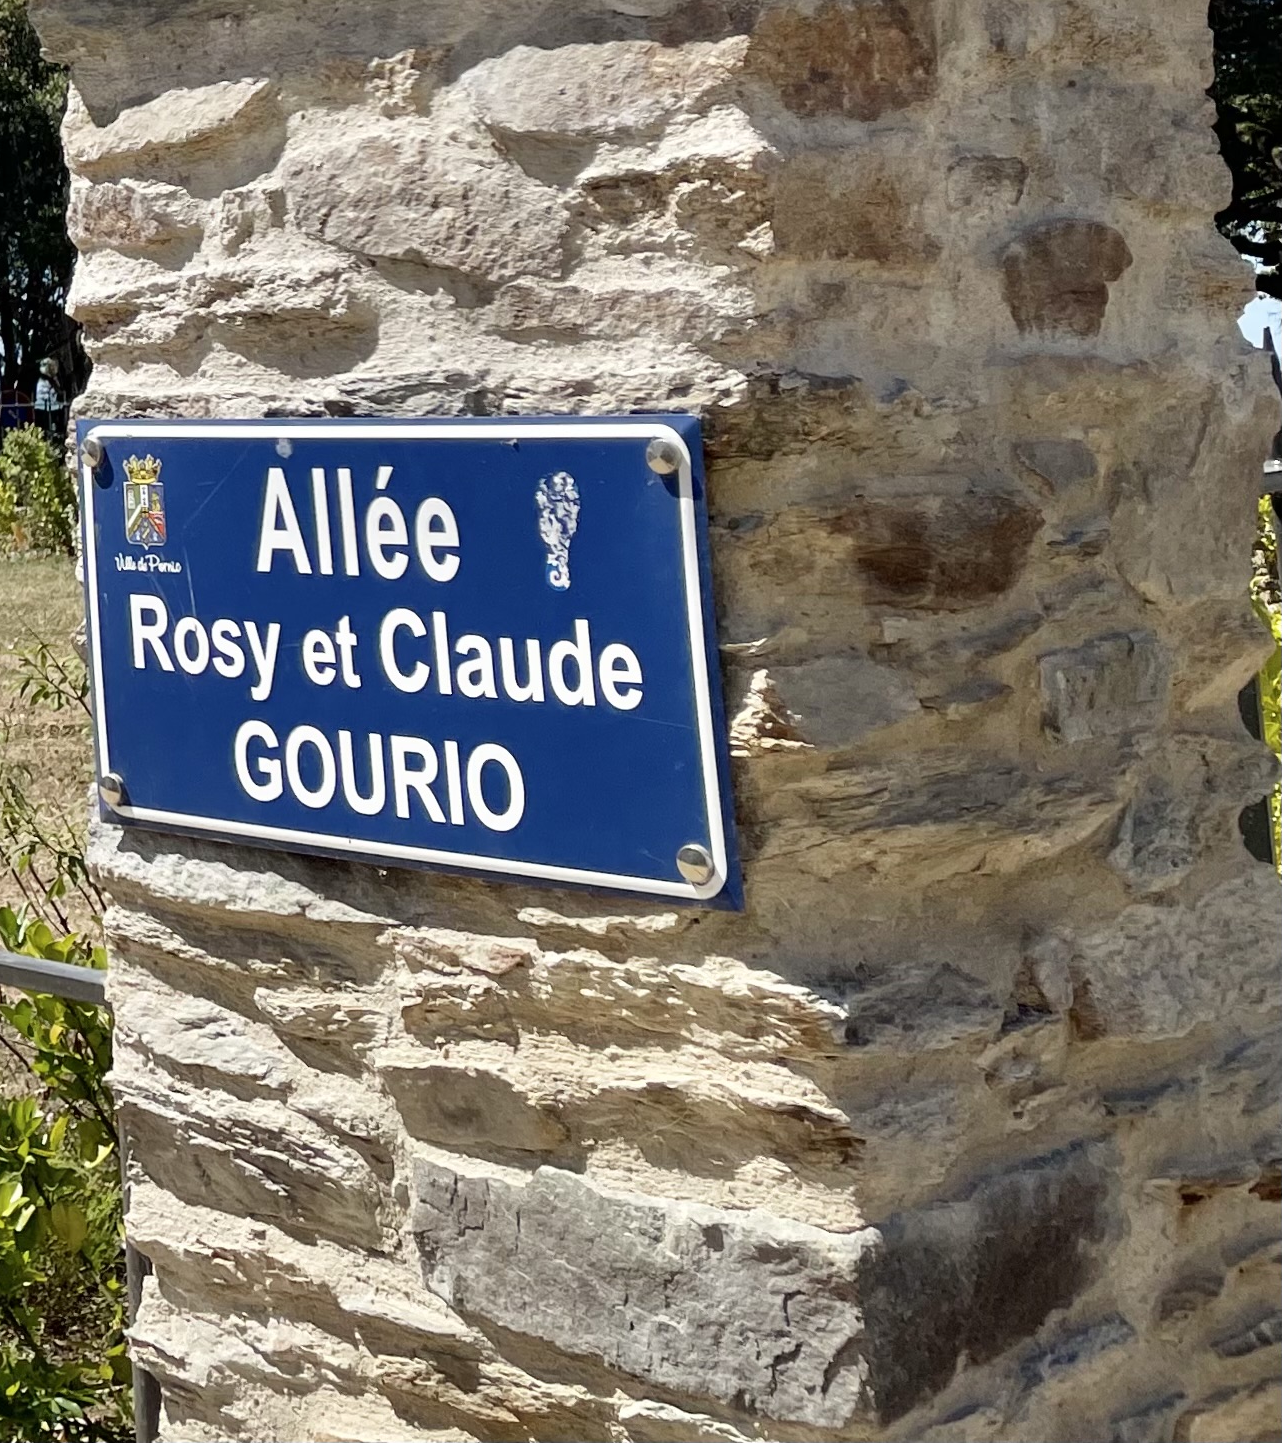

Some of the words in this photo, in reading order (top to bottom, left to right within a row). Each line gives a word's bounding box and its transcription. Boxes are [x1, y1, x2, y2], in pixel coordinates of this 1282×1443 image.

[114, 552, 137, 572] Ville
[256, 465, 461, 583] Allée
[129, 593, 281, 701] Rosy
[302, 615, 362, 689] et
[379, 607, 643, 711] Claude
[234, 719, 525, 832] GOURIO
